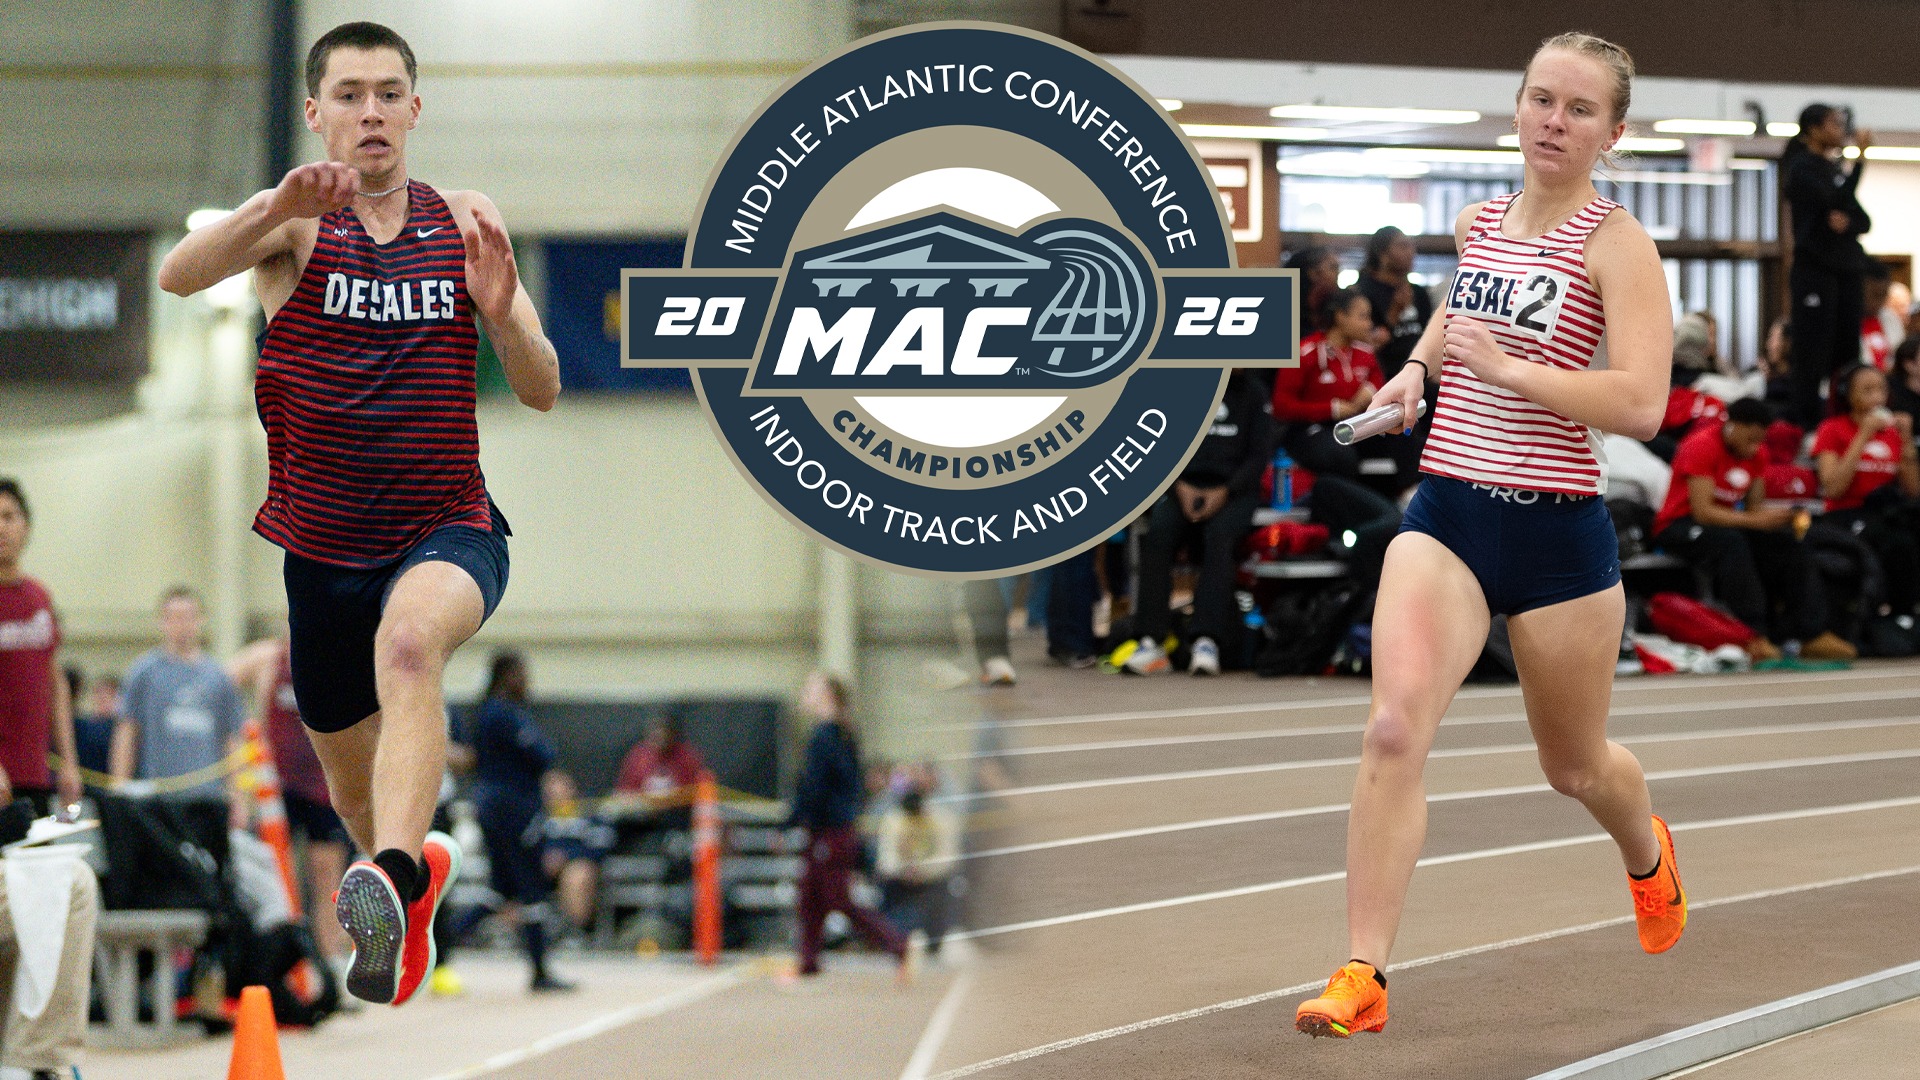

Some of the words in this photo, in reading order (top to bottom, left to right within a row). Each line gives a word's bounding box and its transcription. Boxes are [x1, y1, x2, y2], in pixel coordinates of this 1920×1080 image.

[323, 273, 455, 321] DESALES
[1446, 270, 1516, 317] ESAL
[1515, 275, 1558, 333] 2
